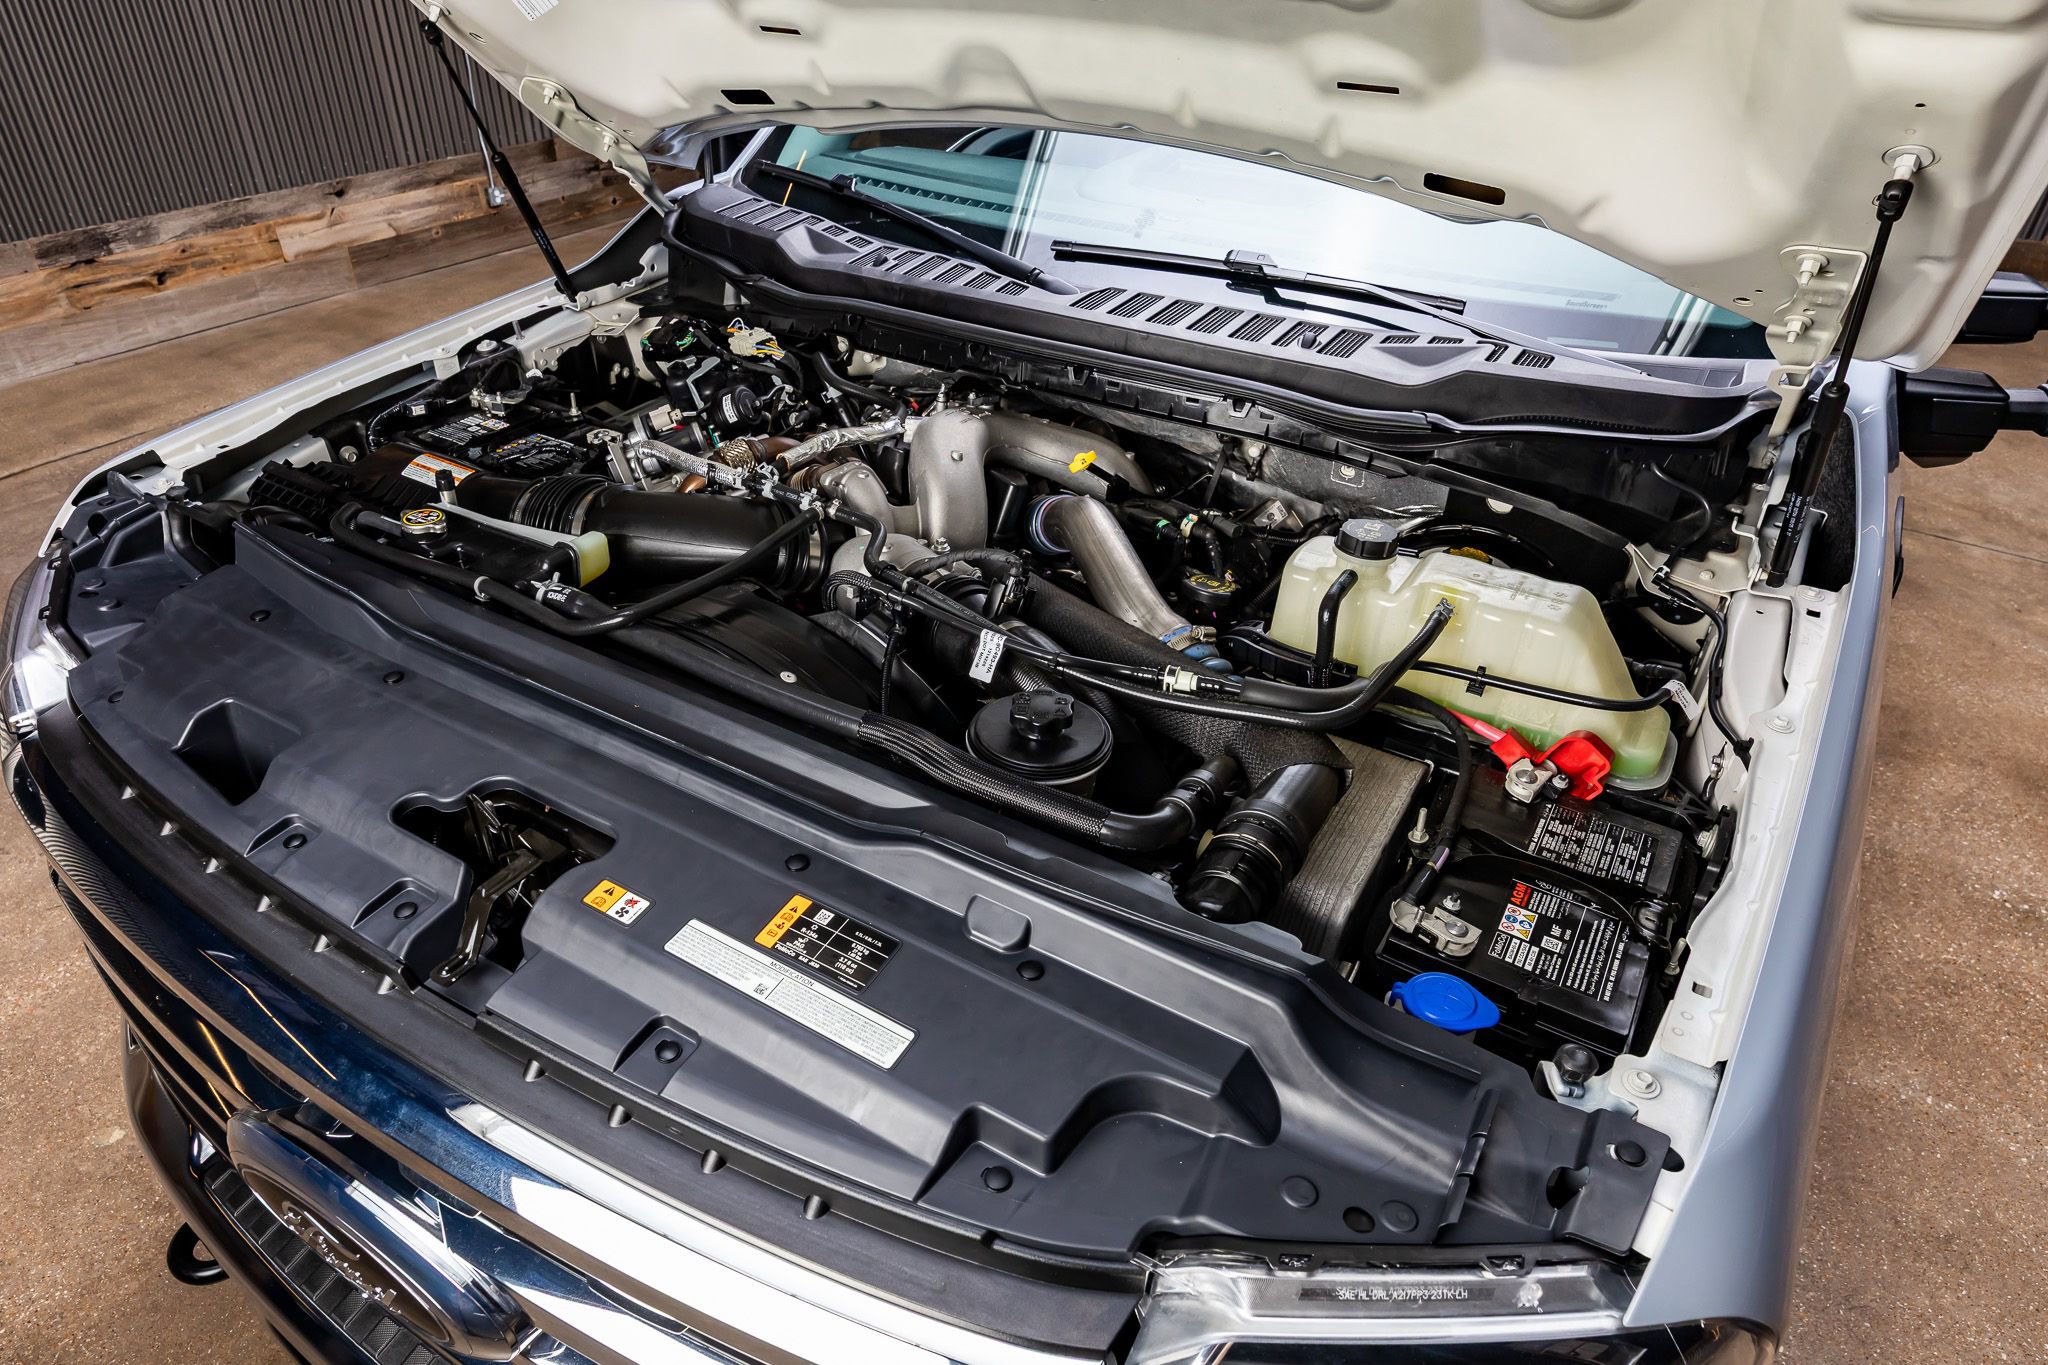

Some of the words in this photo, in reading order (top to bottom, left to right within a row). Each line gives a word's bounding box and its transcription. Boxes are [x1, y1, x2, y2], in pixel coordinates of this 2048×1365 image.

[1510, 883, 1527, 906] AGM
[800, 928, 818, 939] R-134a
[1550, 924, 1562, 937] MF
[774, 944, 796, 957] FoMoCo
[798, 955, 808, 964] SAE
[1492, 934, 1508, 958] FoMoCo
[770, 961, 814, 987] MODIFICATION
[1338, 1290, 1355, 1300] SAE
[1358, 1290, 1369, 1300] HL
[1372, 1290, 1389, 1300] DRL
